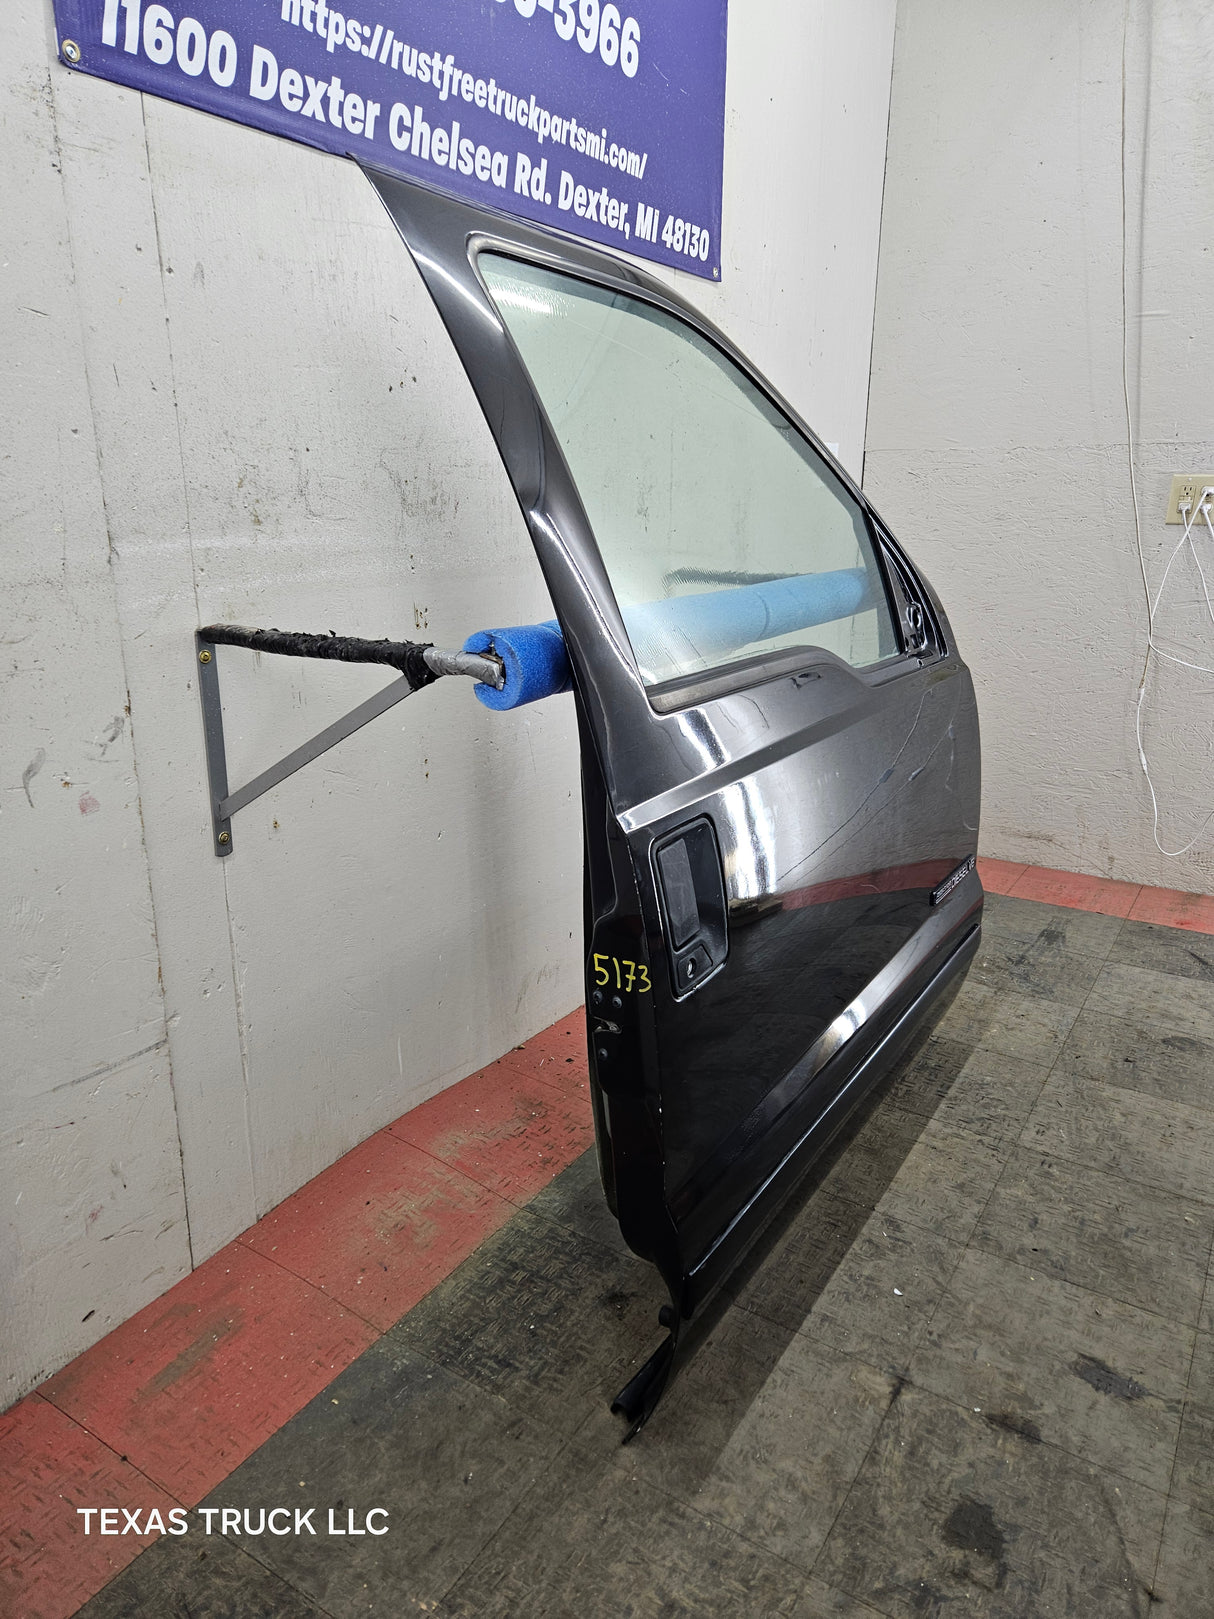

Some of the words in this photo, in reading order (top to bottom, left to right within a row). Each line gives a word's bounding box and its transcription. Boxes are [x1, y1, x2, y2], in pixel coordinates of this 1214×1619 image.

[101, 0, 238, 88] 11600
[249, 44, 381, 140] Dexter
[389, 102, 509, 189] Chelsea
[513, 151, 552, 205] Rd.
[557, 169, 631, 241] Dexter,
[634, 201, 660, 244] MI
[661, 214, 710, 262] 48130
[593, 952, 652, 993] 5173
